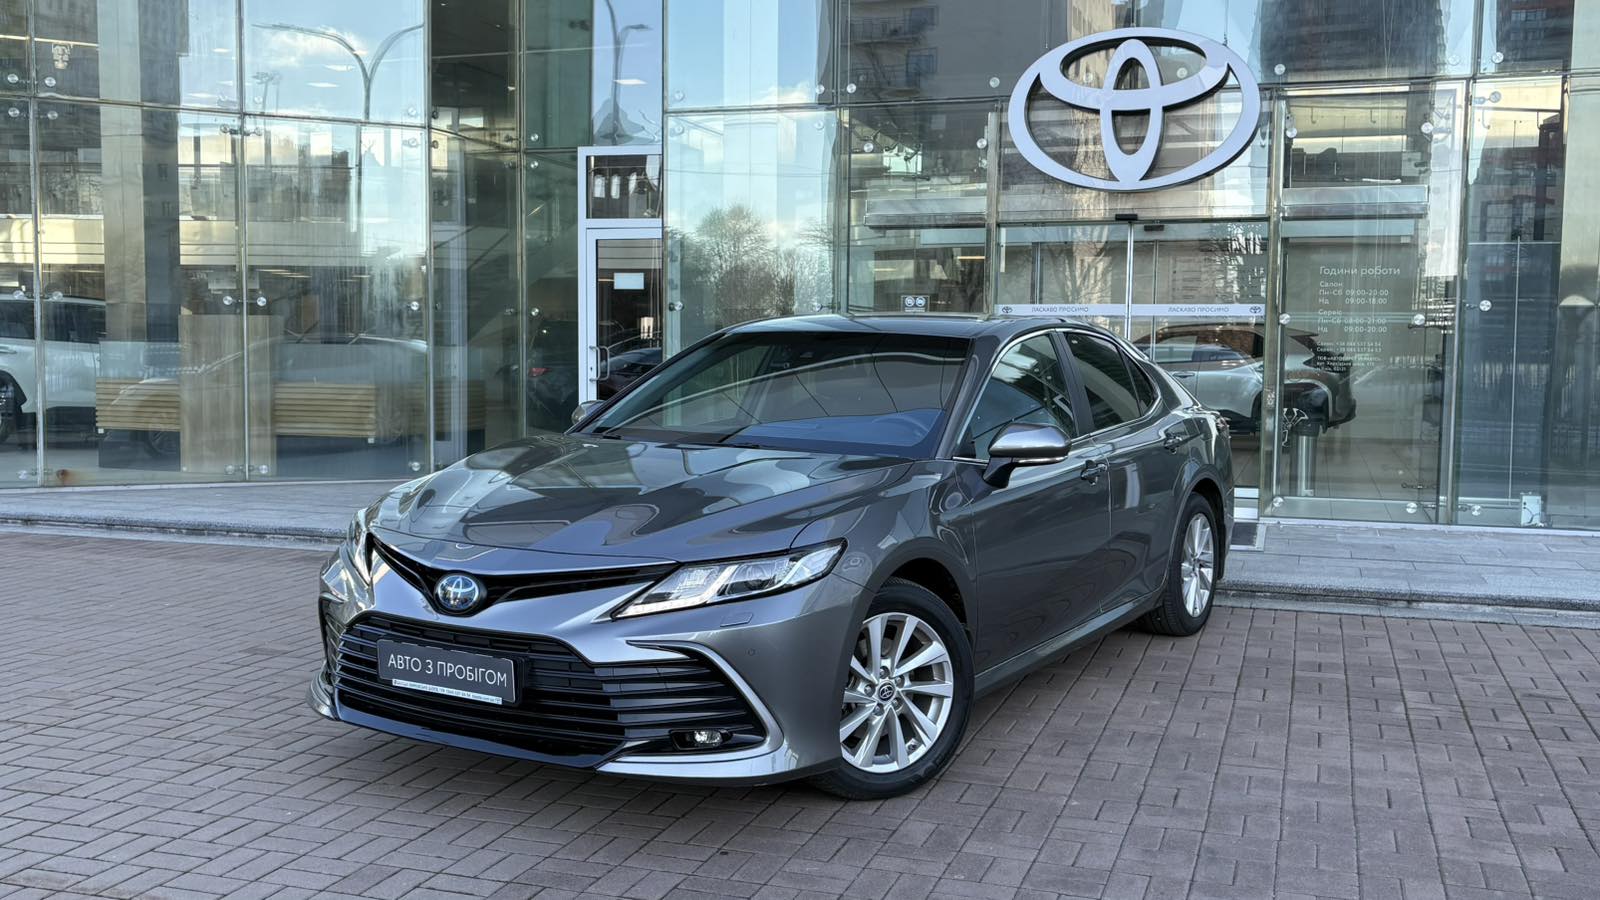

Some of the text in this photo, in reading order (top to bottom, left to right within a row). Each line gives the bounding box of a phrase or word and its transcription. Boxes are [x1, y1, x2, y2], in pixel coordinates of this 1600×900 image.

[1320, 265, 1400, 277] Години роботи
[388, 653, 422, 672] АВТО
[437, 662, 507, 687] ПРОБІГОМ
